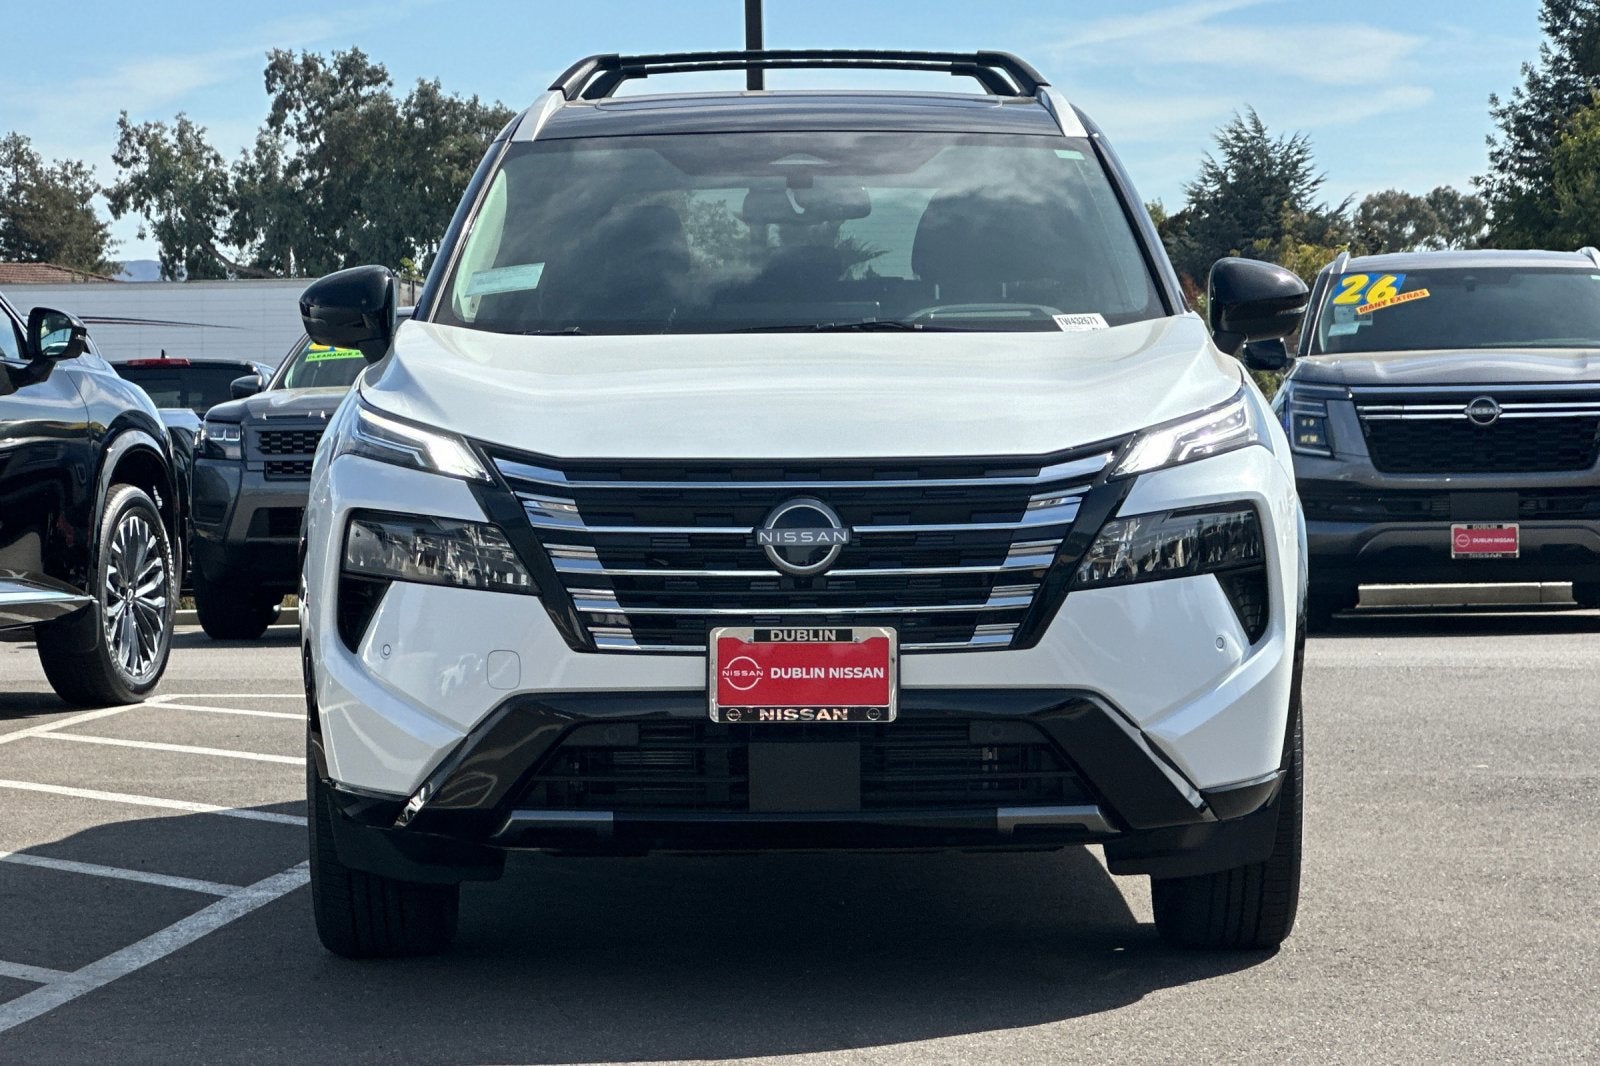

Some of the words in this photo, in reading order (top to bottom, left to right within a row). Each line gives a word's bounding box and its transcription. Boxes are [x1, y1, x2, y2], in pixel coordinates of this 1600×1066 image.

[1332, 274, 1397, 305] 26
[1359, 298, 1388, 313] MANY
[1389, 290, 1426, 304] EXTRAS
[759, 531, 847, 543] NISSAN
[770, 629, 836, 641] DUBLIN
[722, 669, 764, 677] NISSAN
[770, 667, 825, 679] DUBLIN
[829, 667, 884, 679] NISSAN
[759, 708, 848, 721] NISSAN
